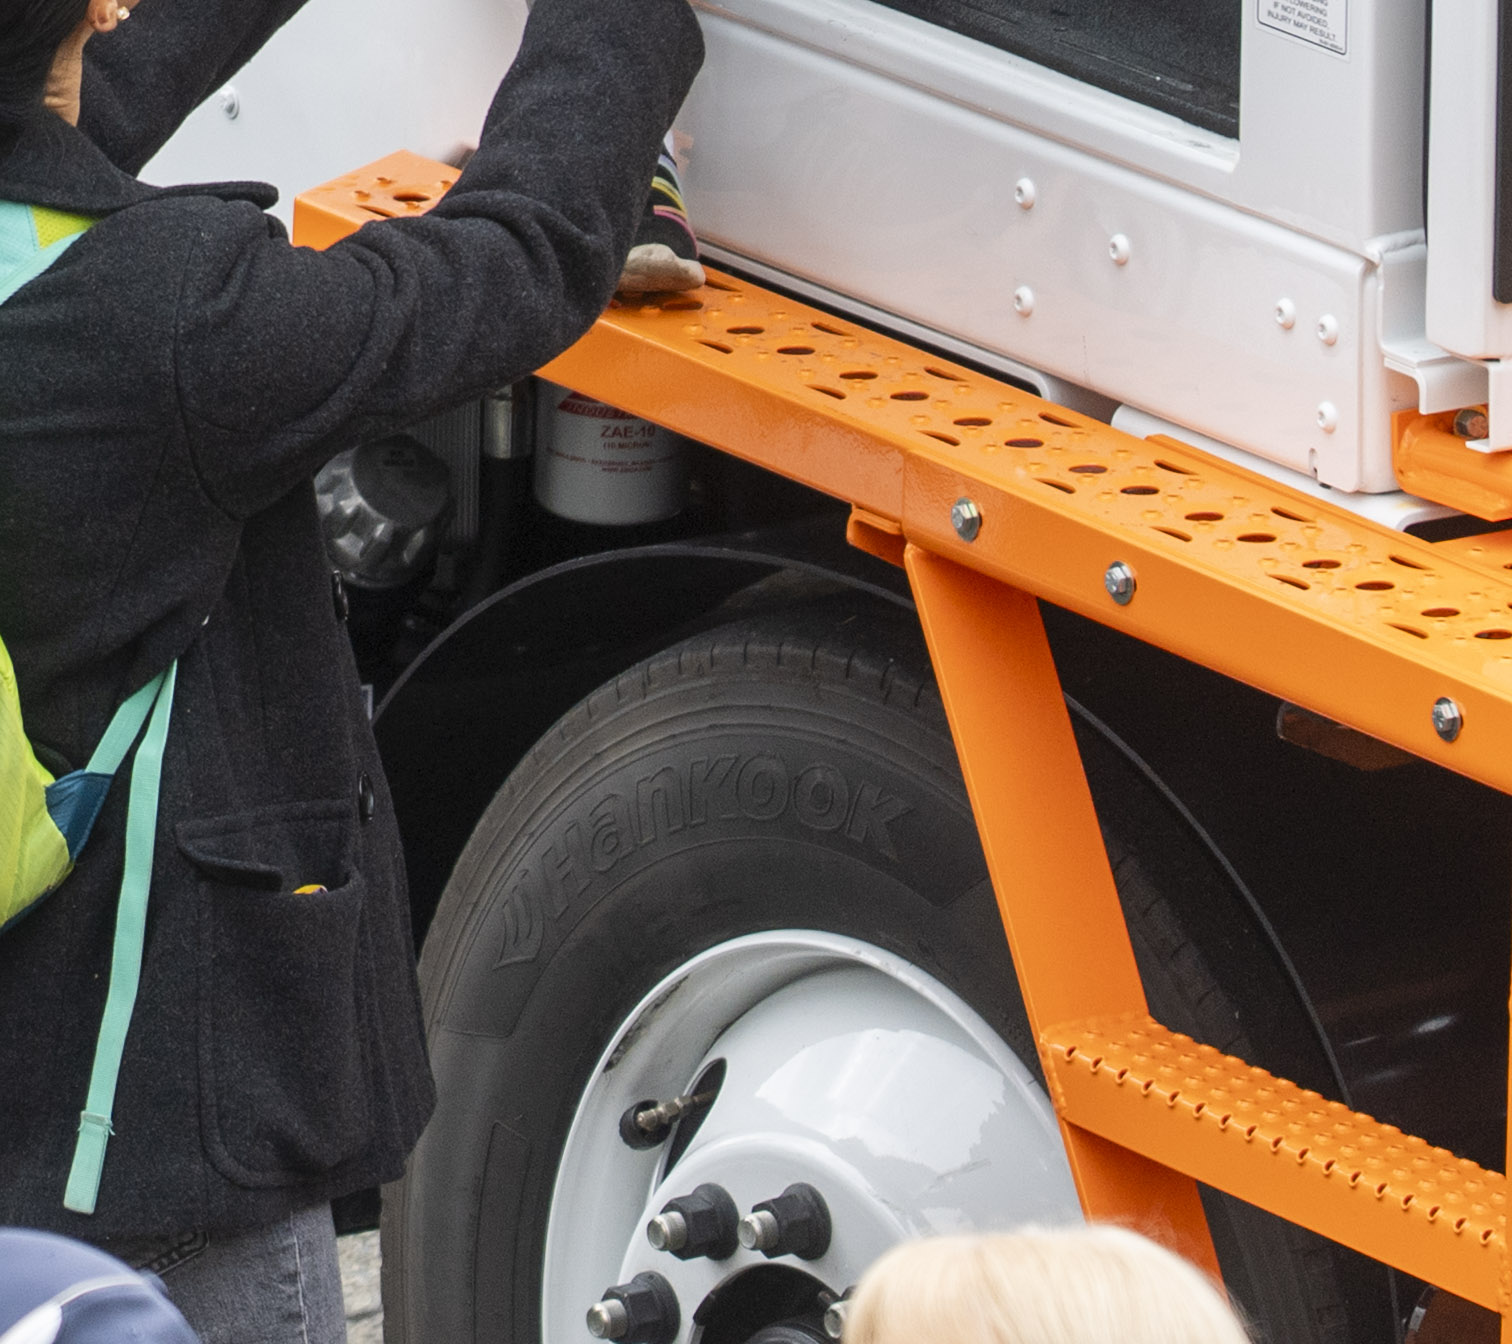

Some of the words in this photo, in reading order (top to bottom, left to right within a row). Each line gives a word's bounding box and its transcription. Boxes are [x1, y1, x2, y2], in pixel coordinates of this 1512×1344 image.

[1281, 4, 1296, 15] NOT
[1267, 10, 1292, 24] INJURY
[1292, 20, 1308, 30] MAY
